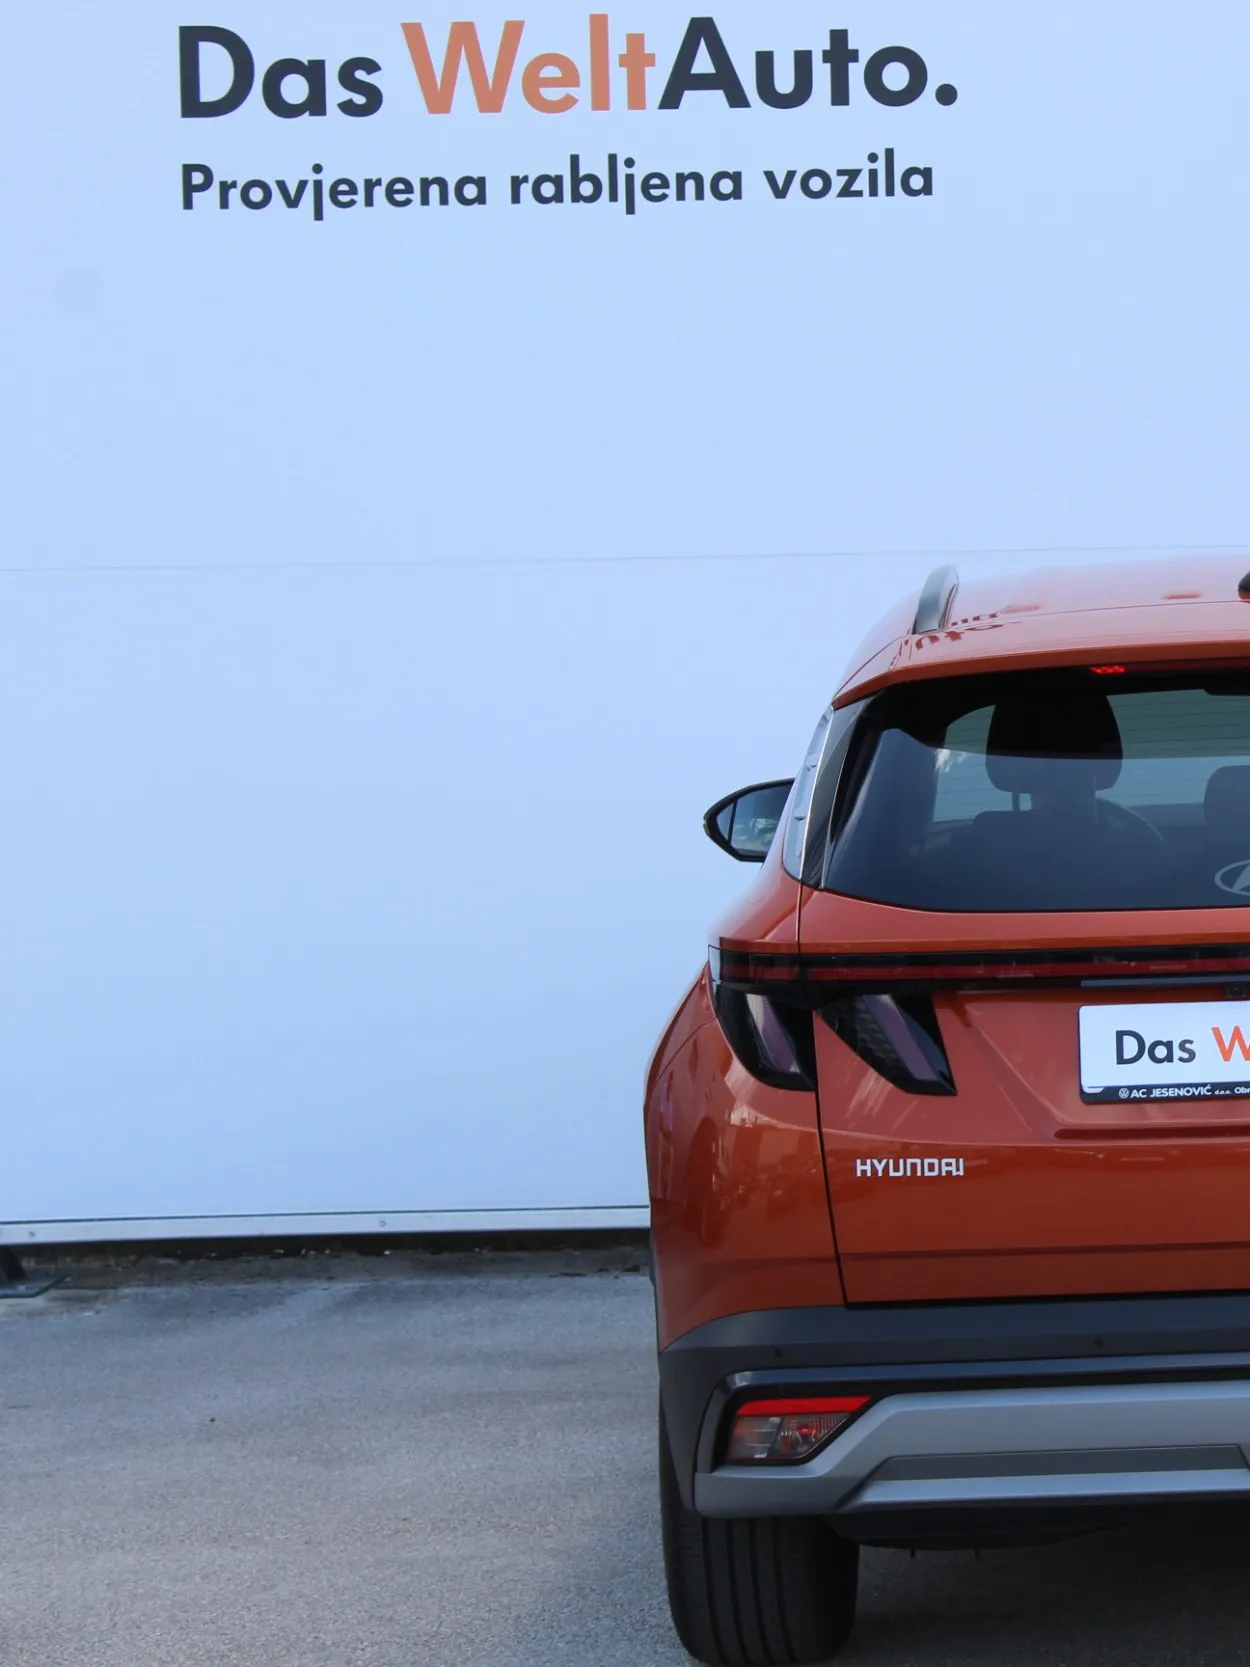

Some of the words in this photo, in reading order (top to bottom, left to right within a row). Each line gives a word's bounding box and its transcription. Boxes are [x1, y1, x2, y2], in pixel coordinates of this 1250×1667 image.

[179, 26, 383, 119] Das
[401, 14, 957, 114] WeltAuto.
[181, 163, 486, 221] Provjerena
[511, 153, 742, 215] rabljena
[763, 148, 933, 199] vozila
[1115, 1030, 1196, 1065] Das
[1130, 1089, 1147, 1098] AC
[1150, 1084, 1212, 1098] JESENOVIĆ
[856, 1158, 964, 1177] HYUNDAI
